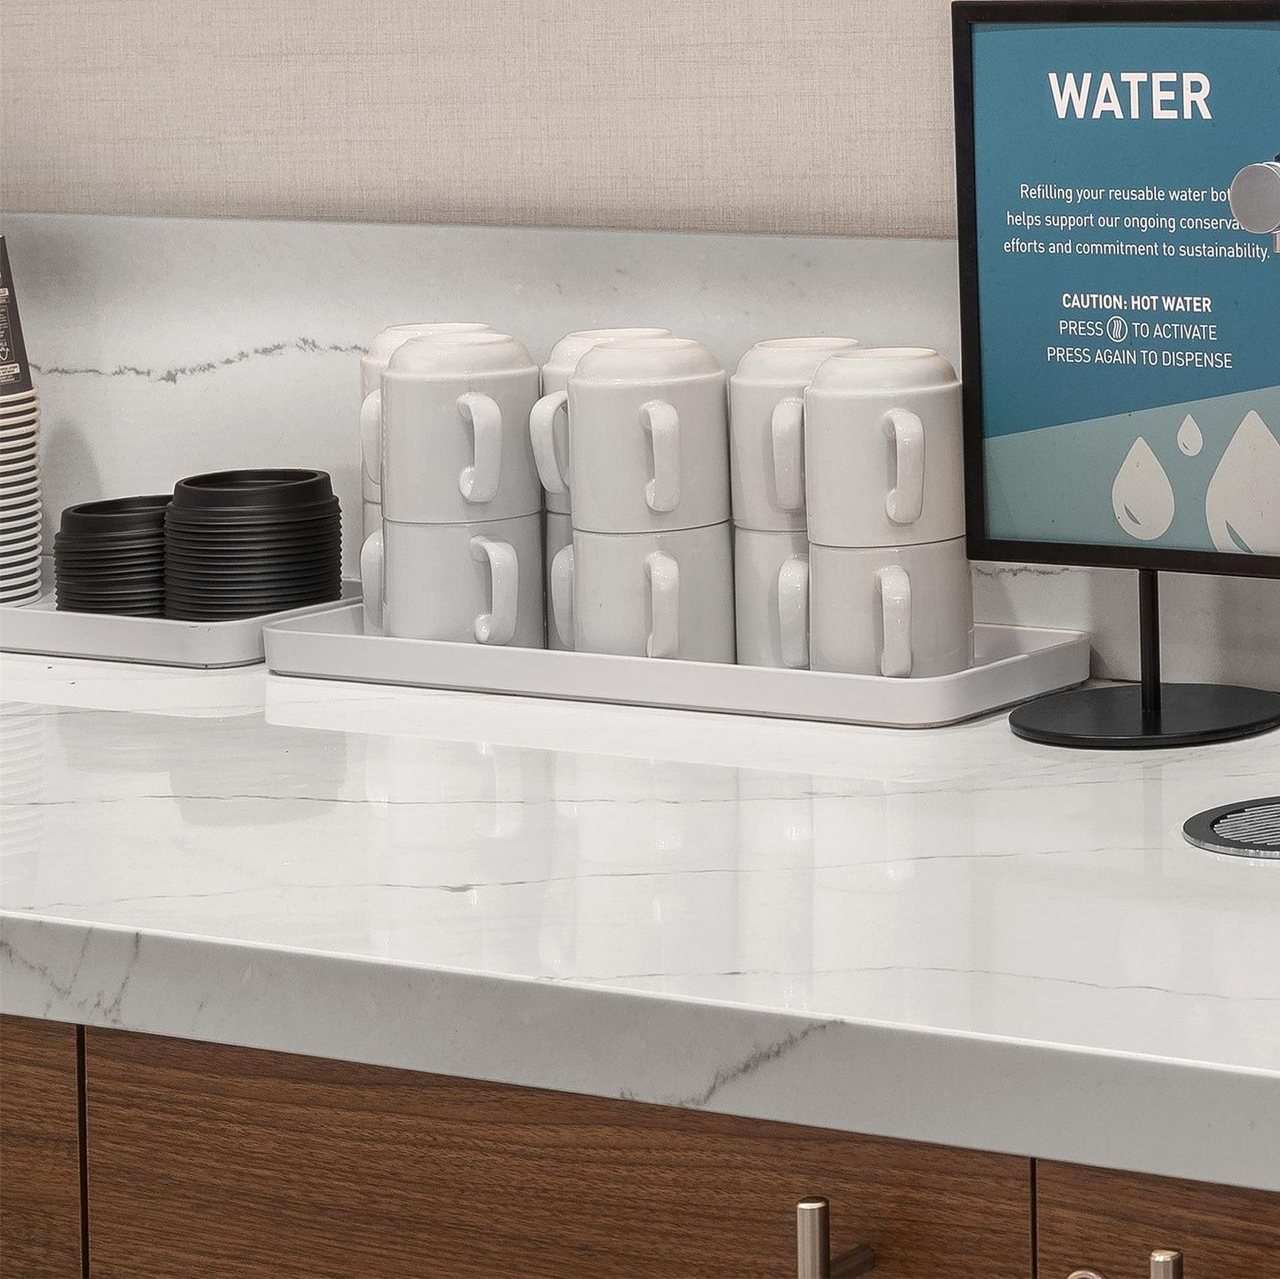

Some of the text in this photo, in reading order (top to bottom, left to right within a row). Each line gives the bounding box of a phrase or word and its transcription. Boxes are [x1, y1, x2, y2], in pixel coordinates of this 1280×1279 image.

[1048, 71, 1213, 120] WATER
[1020, 184, 1232, 204] Refilling your reusable water bot
[1006, 210, 1244, 233] helps support our ongoing conserva
[1003, 239, 1271, 263] efforts and commitment to sustainability.
[1062, 293, 1212, 313] CAUTION: HOT WATER
[1059, 320, 1217, 341] PRESS TO ACTIVATE
[1046, 346, 1233, 369] PRESS AGAIN TO DISPENSE
